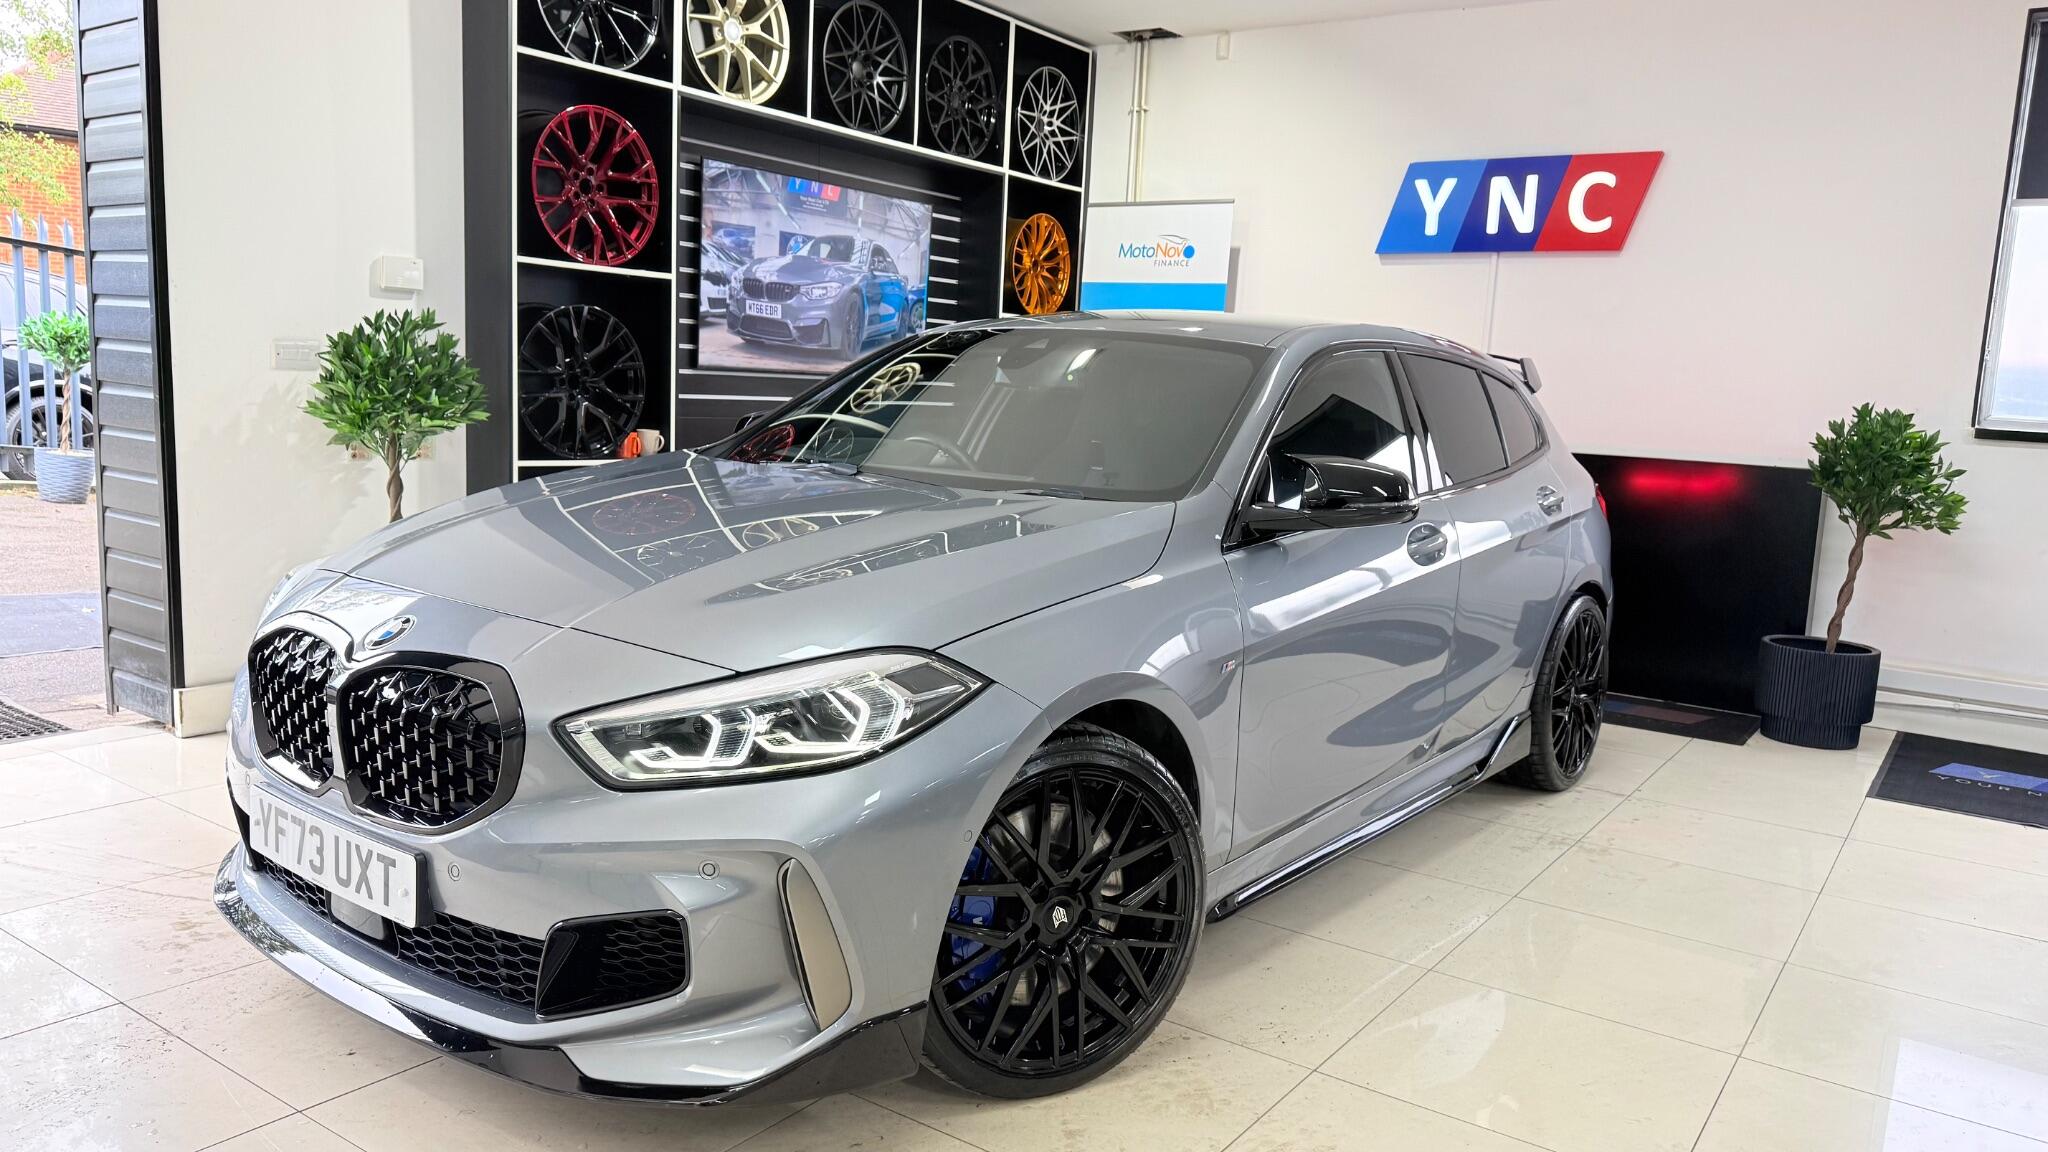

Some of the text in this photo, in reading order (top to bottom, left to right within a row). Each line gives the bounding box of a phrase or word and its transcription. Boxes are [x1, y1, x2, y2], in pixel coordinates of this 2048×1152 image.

[1414, 171, 1617, 236] YNC
[1936, 775, 2010, 791] YOUR
[259, 798, 397, 907] YF73 UXT
